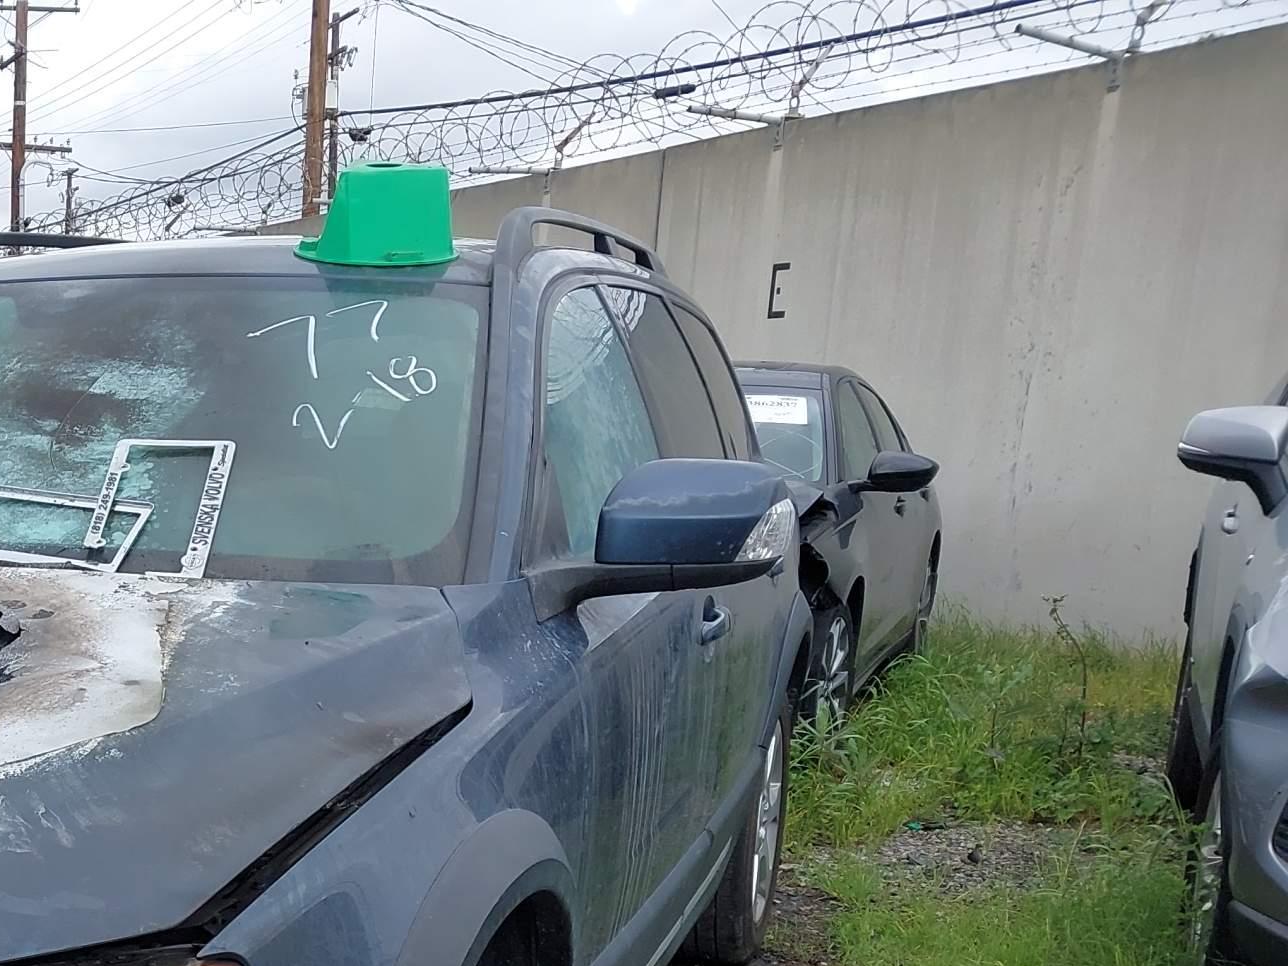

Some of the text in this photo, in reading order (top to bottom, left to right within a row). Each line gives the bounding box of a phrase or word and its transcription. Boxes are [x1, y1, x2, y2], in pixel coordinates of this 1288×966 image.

[767, 261, 791, 320] E
[246, 299, 389, 380] 77
[90, 471, 119, 535] (818) 249-1981
[205, 471, 225, 502] VOLVO
[191, 502, 220, 546] SVENSKA
